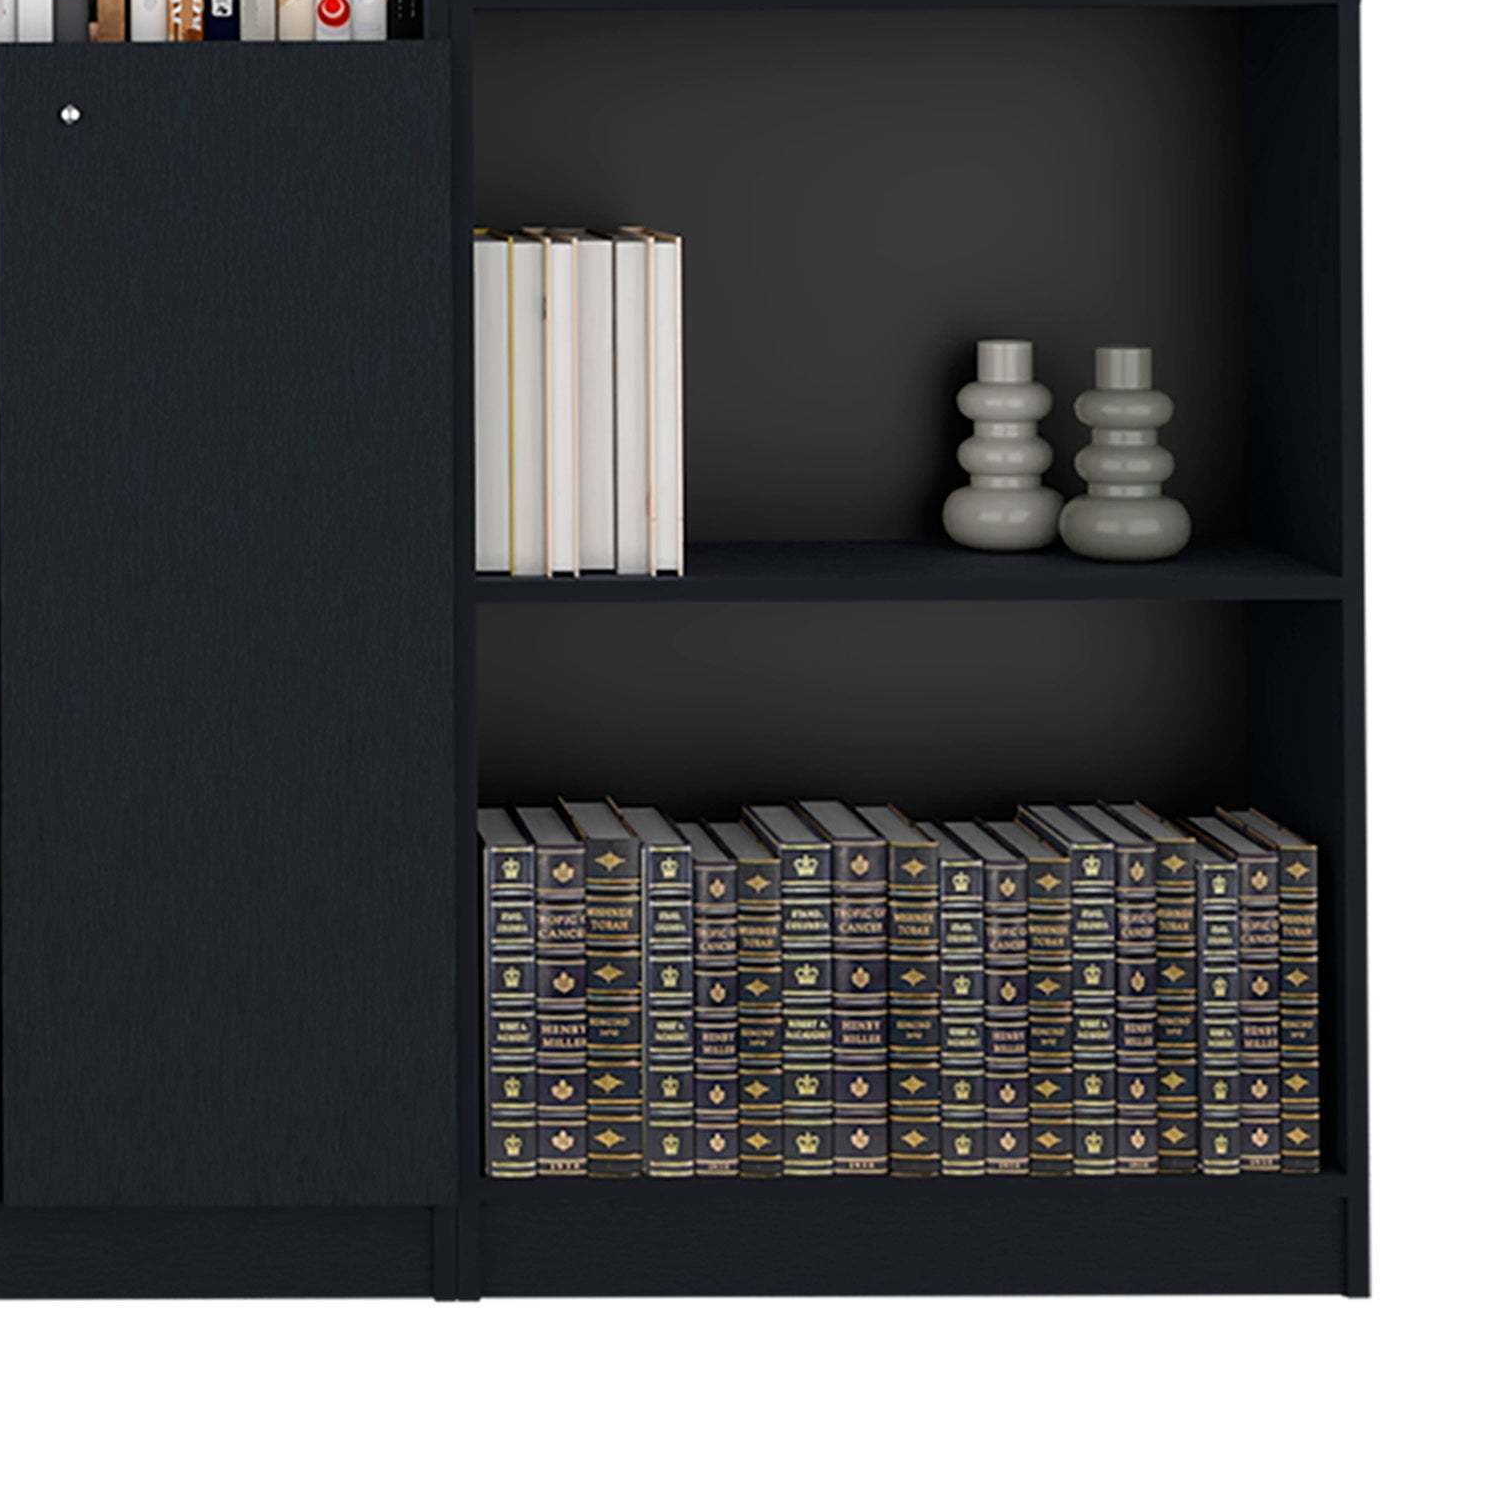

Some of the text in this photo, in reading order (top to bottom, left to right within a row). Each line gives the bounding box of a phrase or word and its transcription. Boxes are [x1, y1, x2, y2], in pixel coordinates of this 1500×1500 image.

[837, 921, 883, 933] CANCER
[537, 928, 586, 940] CANCE
[841, 1020, 881, 1031] HENRY
